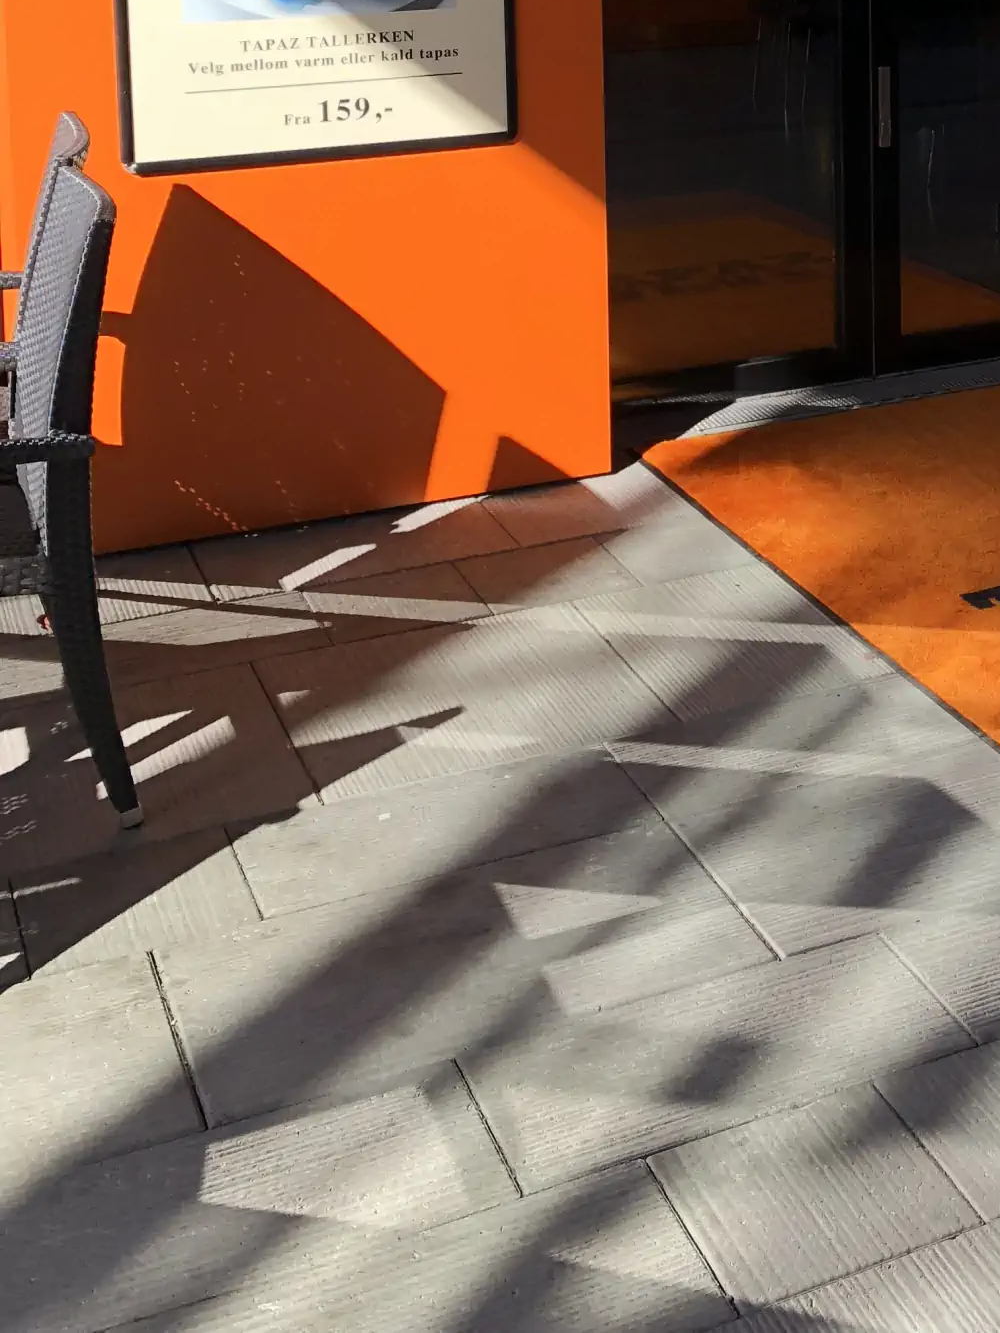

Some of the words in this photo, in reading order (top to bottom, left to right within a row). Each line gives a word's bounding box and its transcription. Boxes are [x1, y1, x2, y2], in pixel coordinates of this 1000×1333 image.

[240, 37, 301, 53] TAPAZ
[306, 29, 415, 49] TALLERKEN
[188, 61, 225, 76] Velg
[230, 58, 289, 72] mellom
[295, 57, 335, 69] varm
[340, 52, 376, 66] eller
[381, 48, 414, 62] kald
[419, 46, 460, 61] tapas
[283, 113, 312, 126] Fra
[317, 97, 394, 123] 159,-
